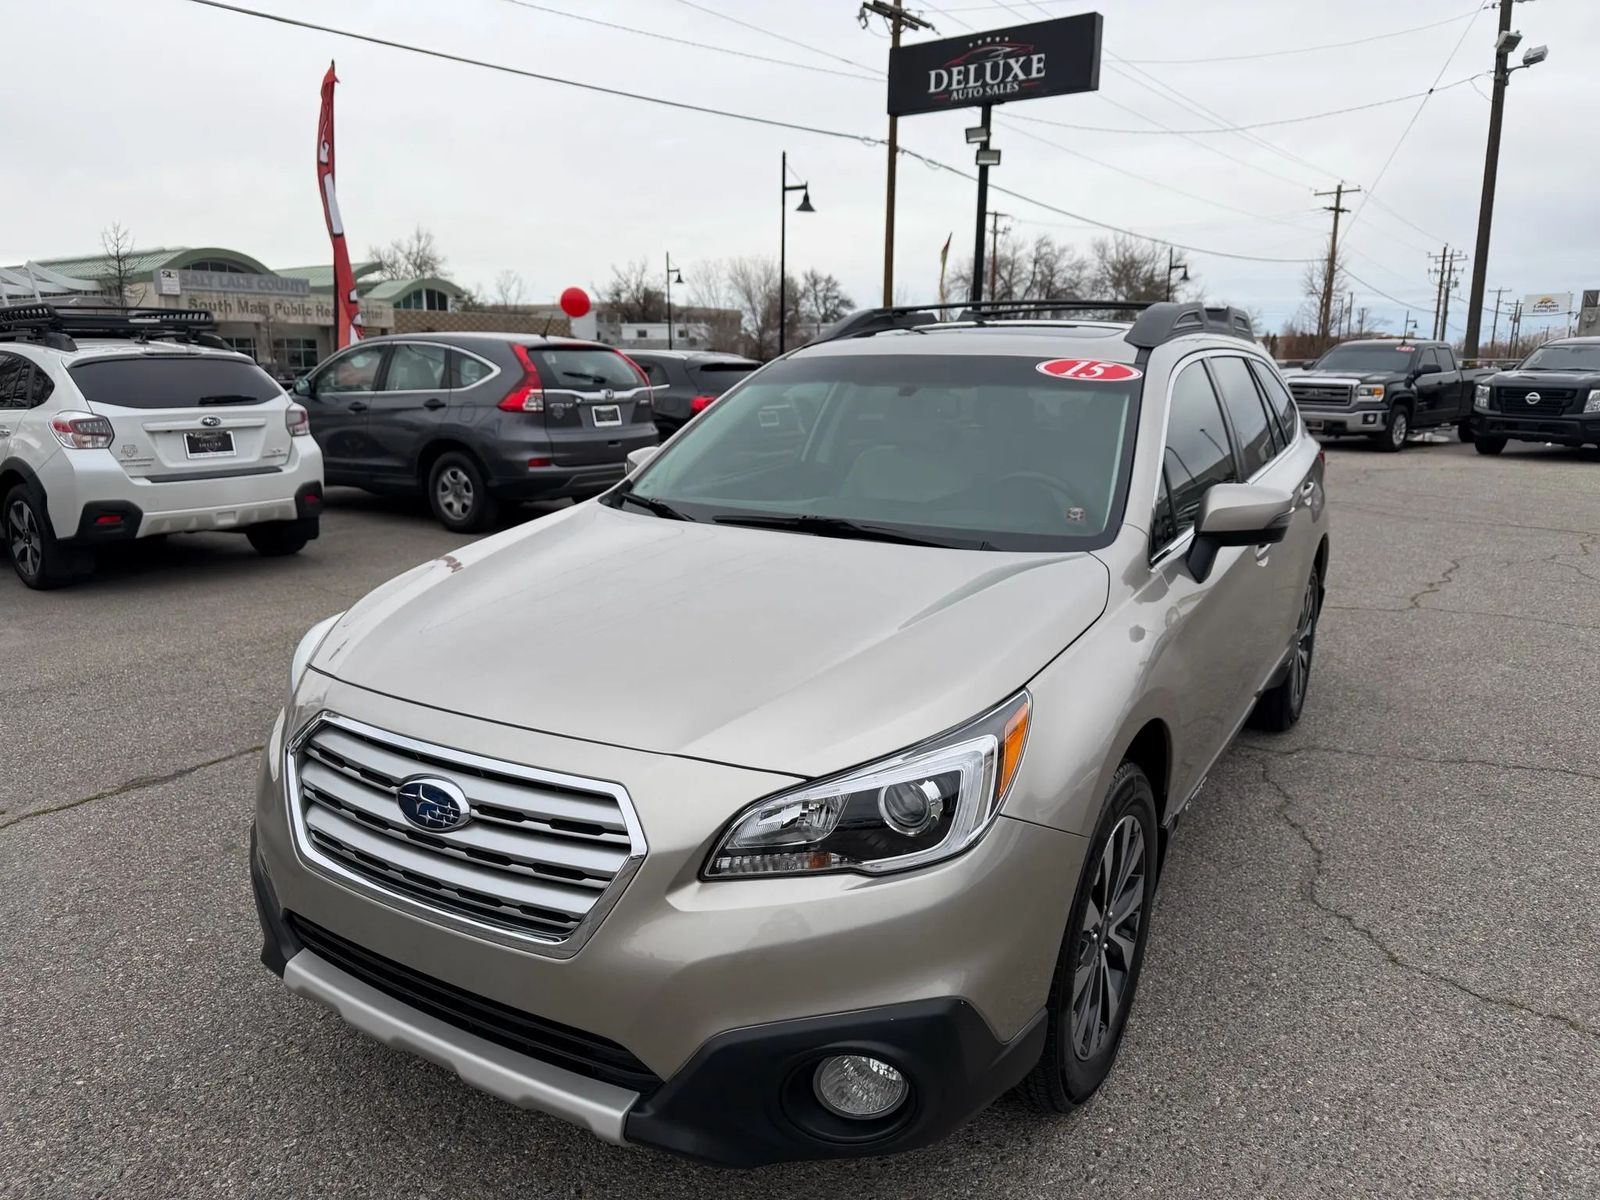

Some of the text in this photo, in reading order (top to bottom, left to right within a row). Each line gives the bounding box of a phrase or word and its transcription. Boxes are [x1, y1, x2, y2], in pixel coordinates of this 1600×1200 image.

[928, 54, 1046, 93] DELUXE
[950, 81, 1019, 100] AUTO SALES
[257, 278, 308, 293] COUNTY
[188, 298, 232, 313] South
[237, 300, 270, 315] Main
[274, 302, 313, 316] Public
[1059, 361, 1114, 378] 15
